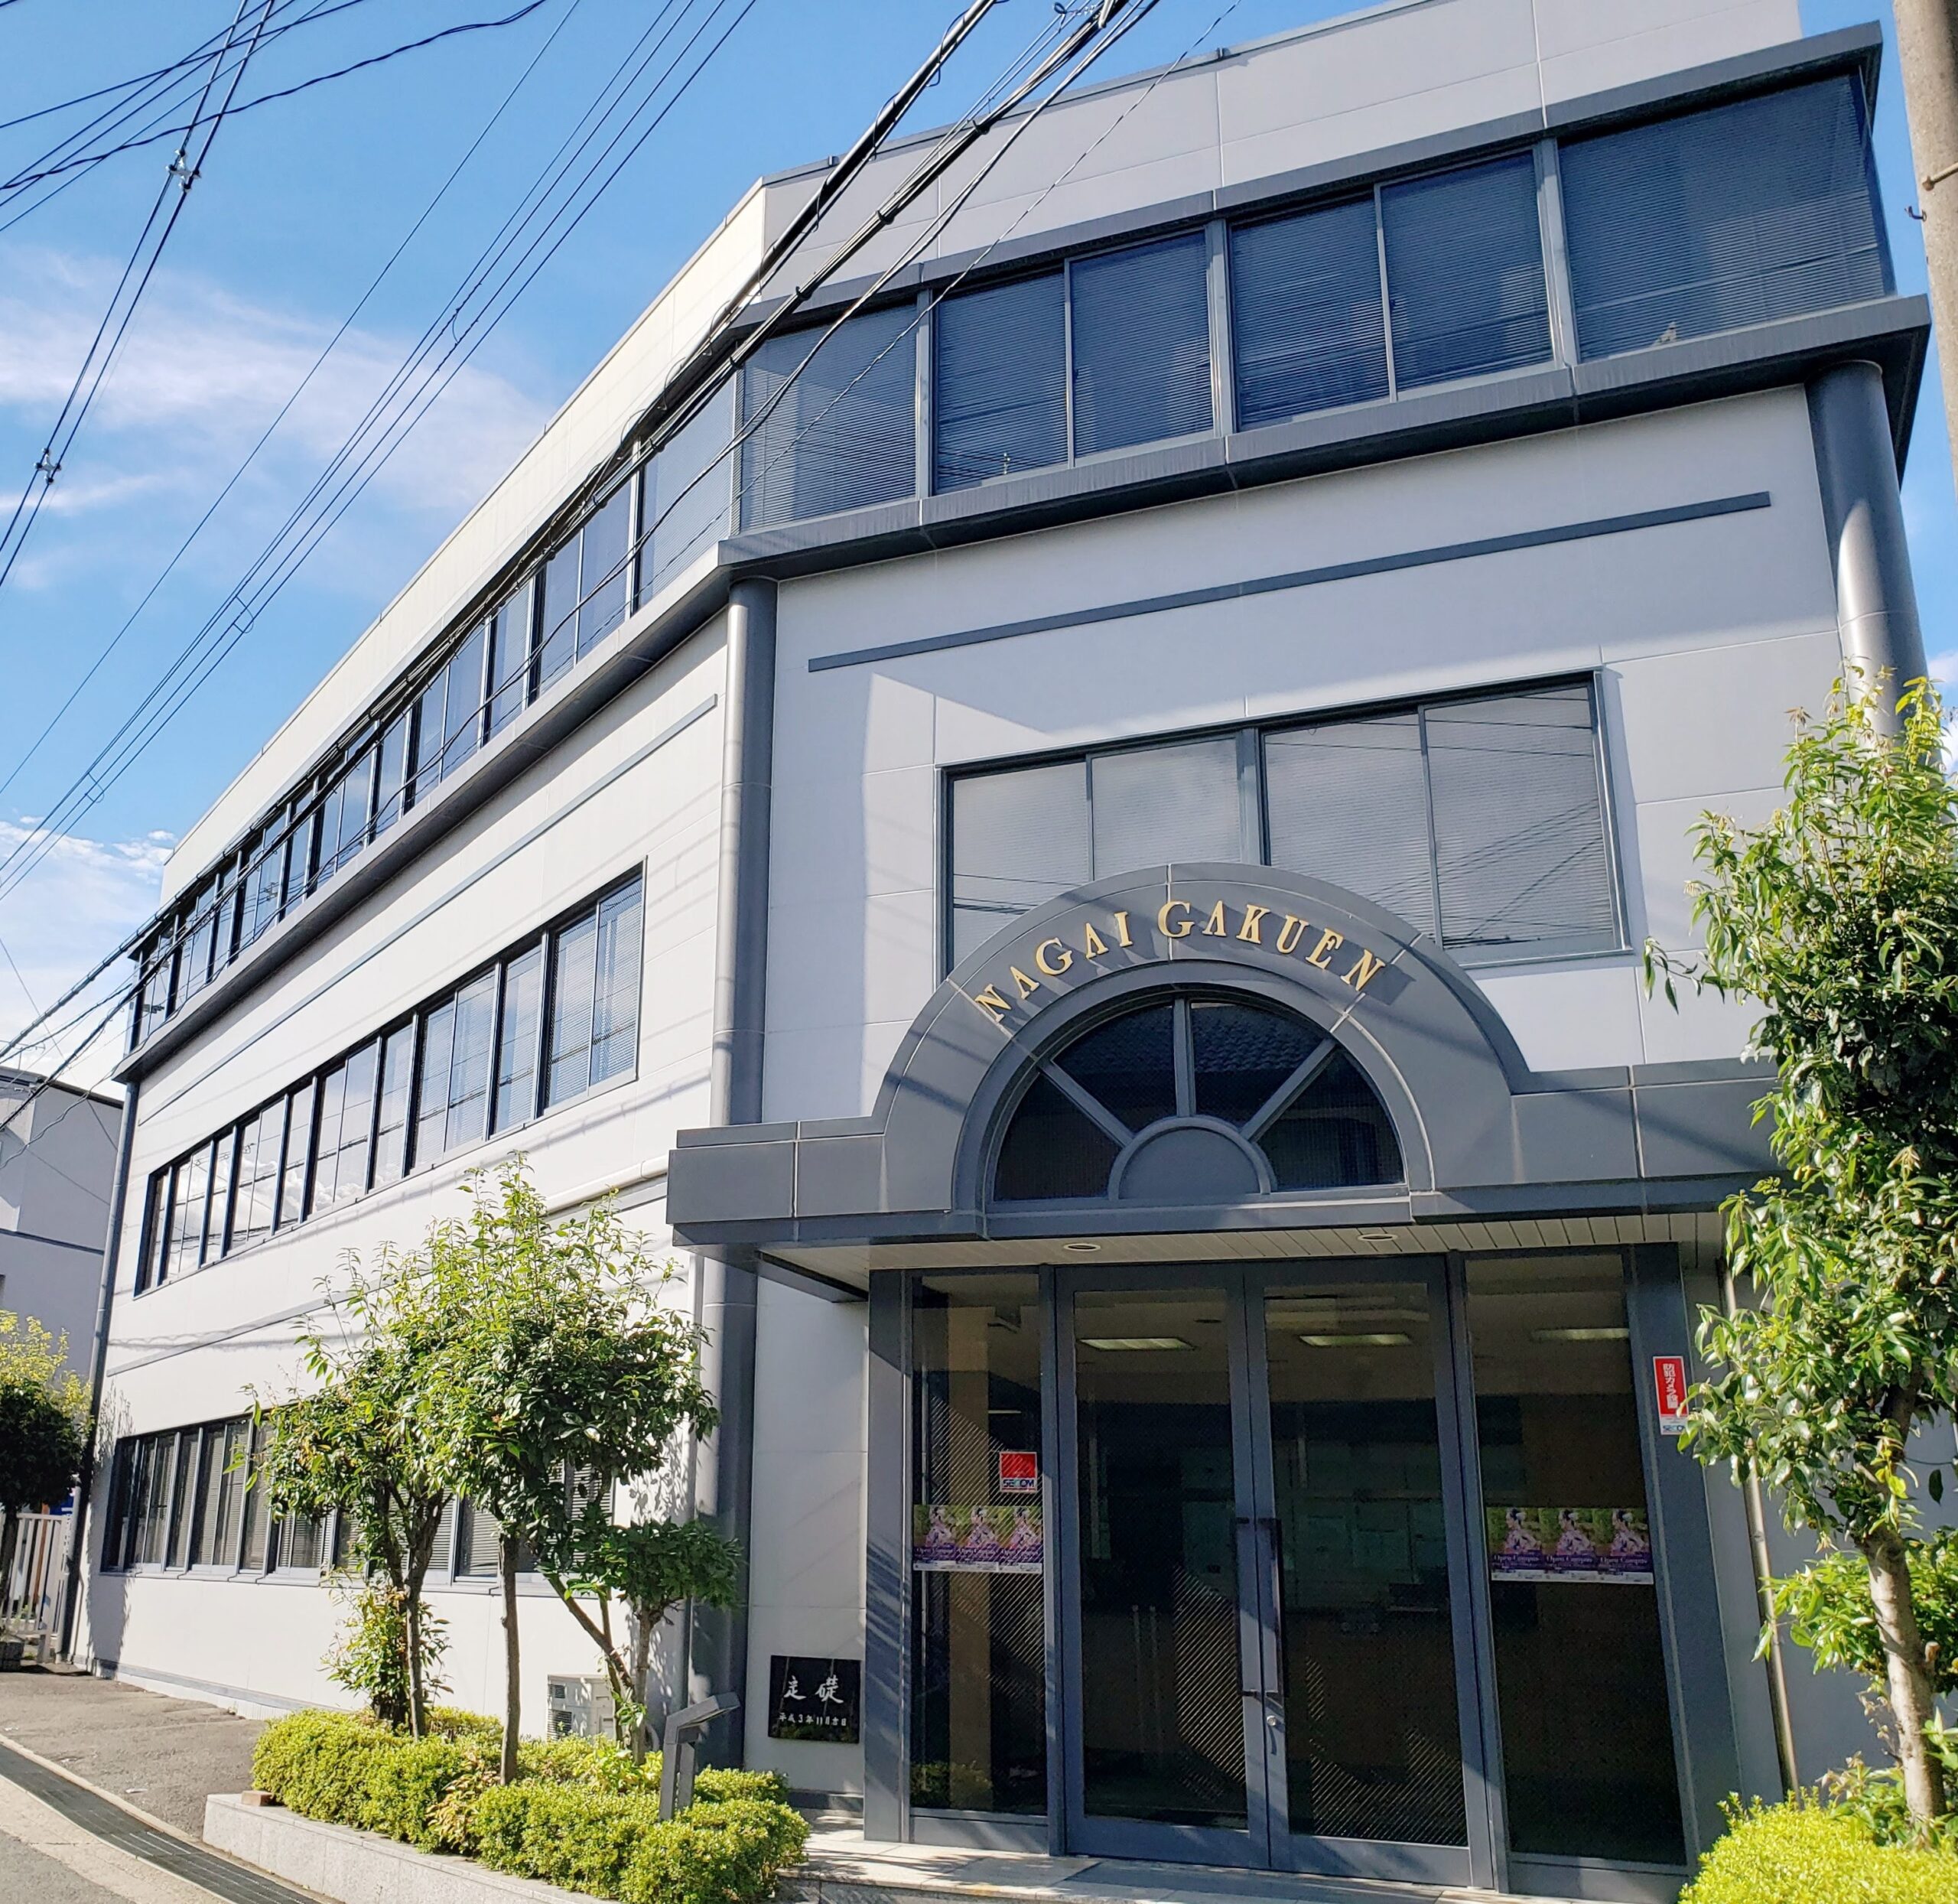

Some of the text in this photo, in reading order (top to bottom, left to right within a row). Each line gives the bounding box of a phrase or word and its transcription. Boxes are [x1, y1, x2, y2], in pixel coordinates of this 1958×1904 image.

[974, 899, 1387, 1024] NAGAI GAKUEN
[1003, 1479, 1035, 1488] SECOM
[783, 1675, 844, 1704] 定礎
